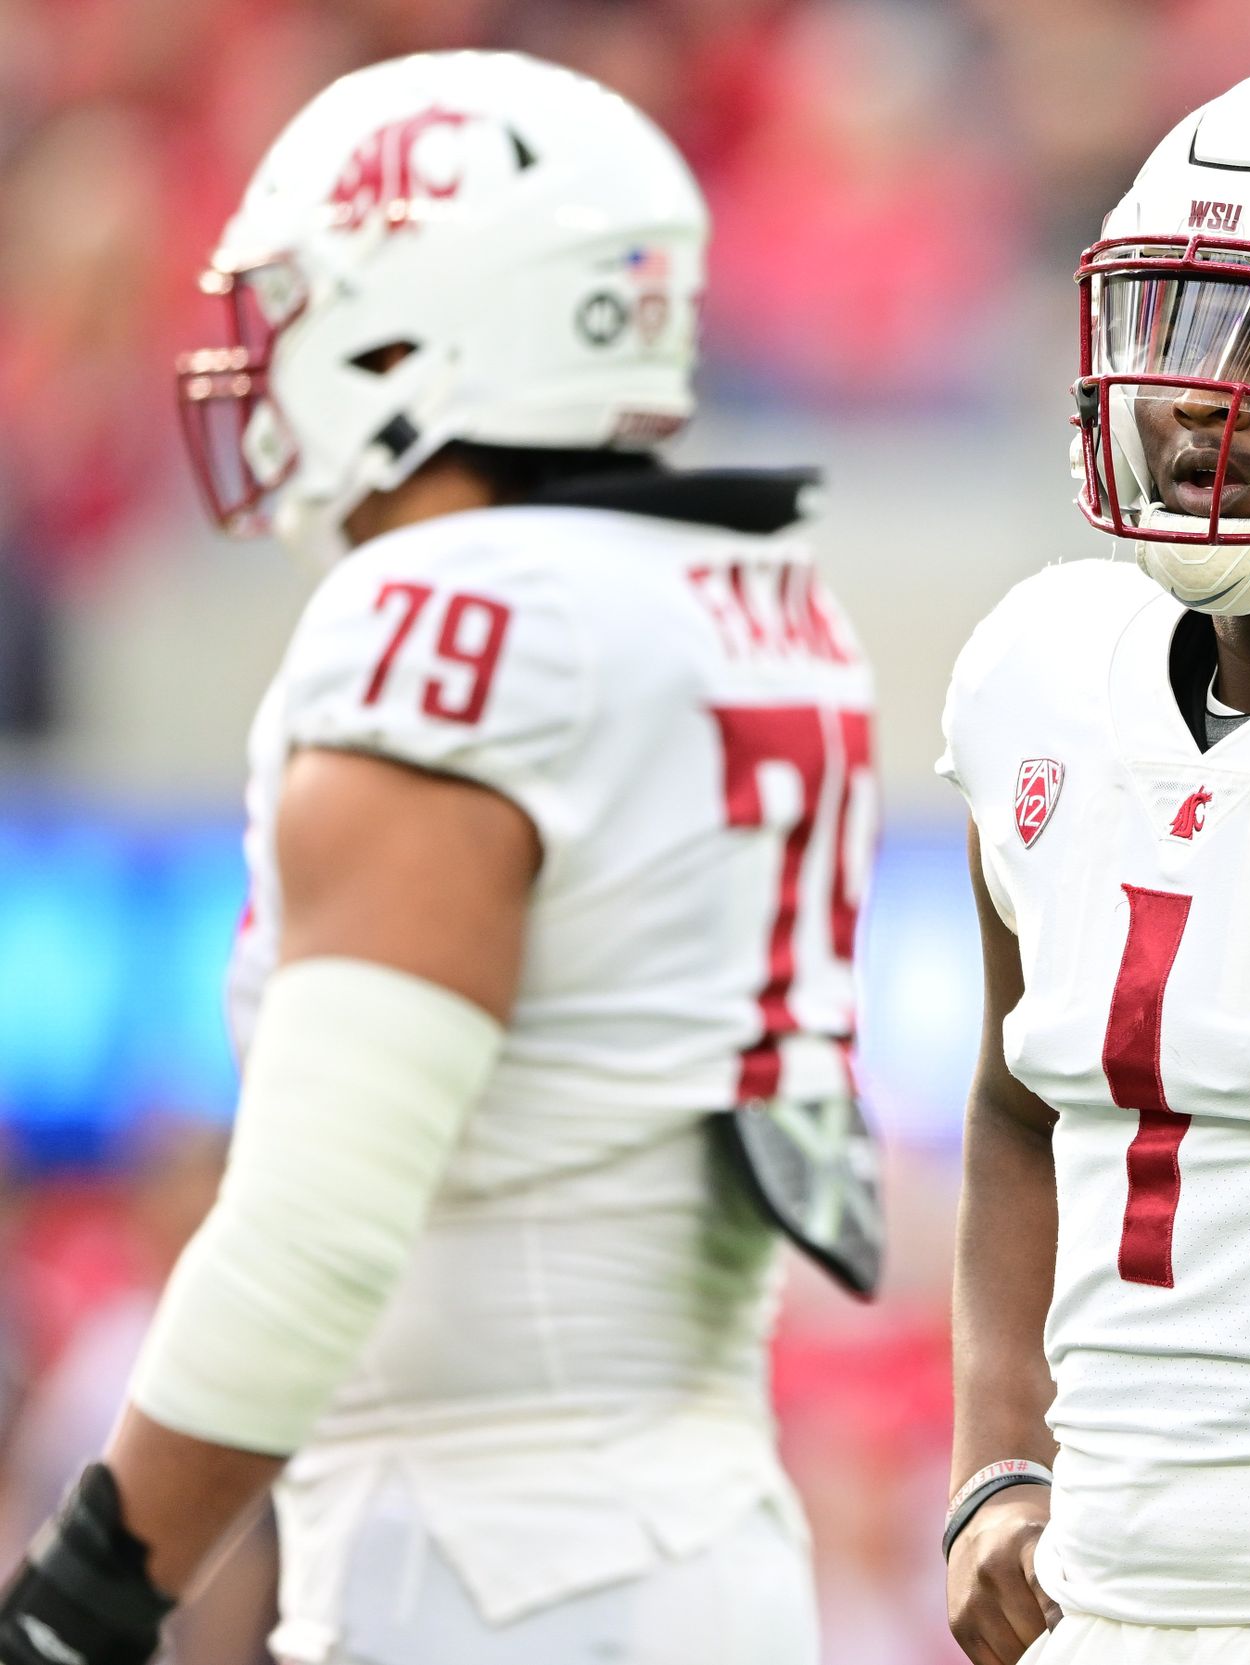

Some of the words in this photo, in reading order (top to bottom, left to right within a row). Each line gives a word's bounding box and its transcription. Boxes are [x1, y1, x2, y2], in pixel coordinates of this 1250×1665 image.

[1188, 200, 1242, 232] WSU
[362, 582, 512, 726] 79
[1019, 794, 1045, 827] 12
[1102, 883, 1194, 1288] 1
